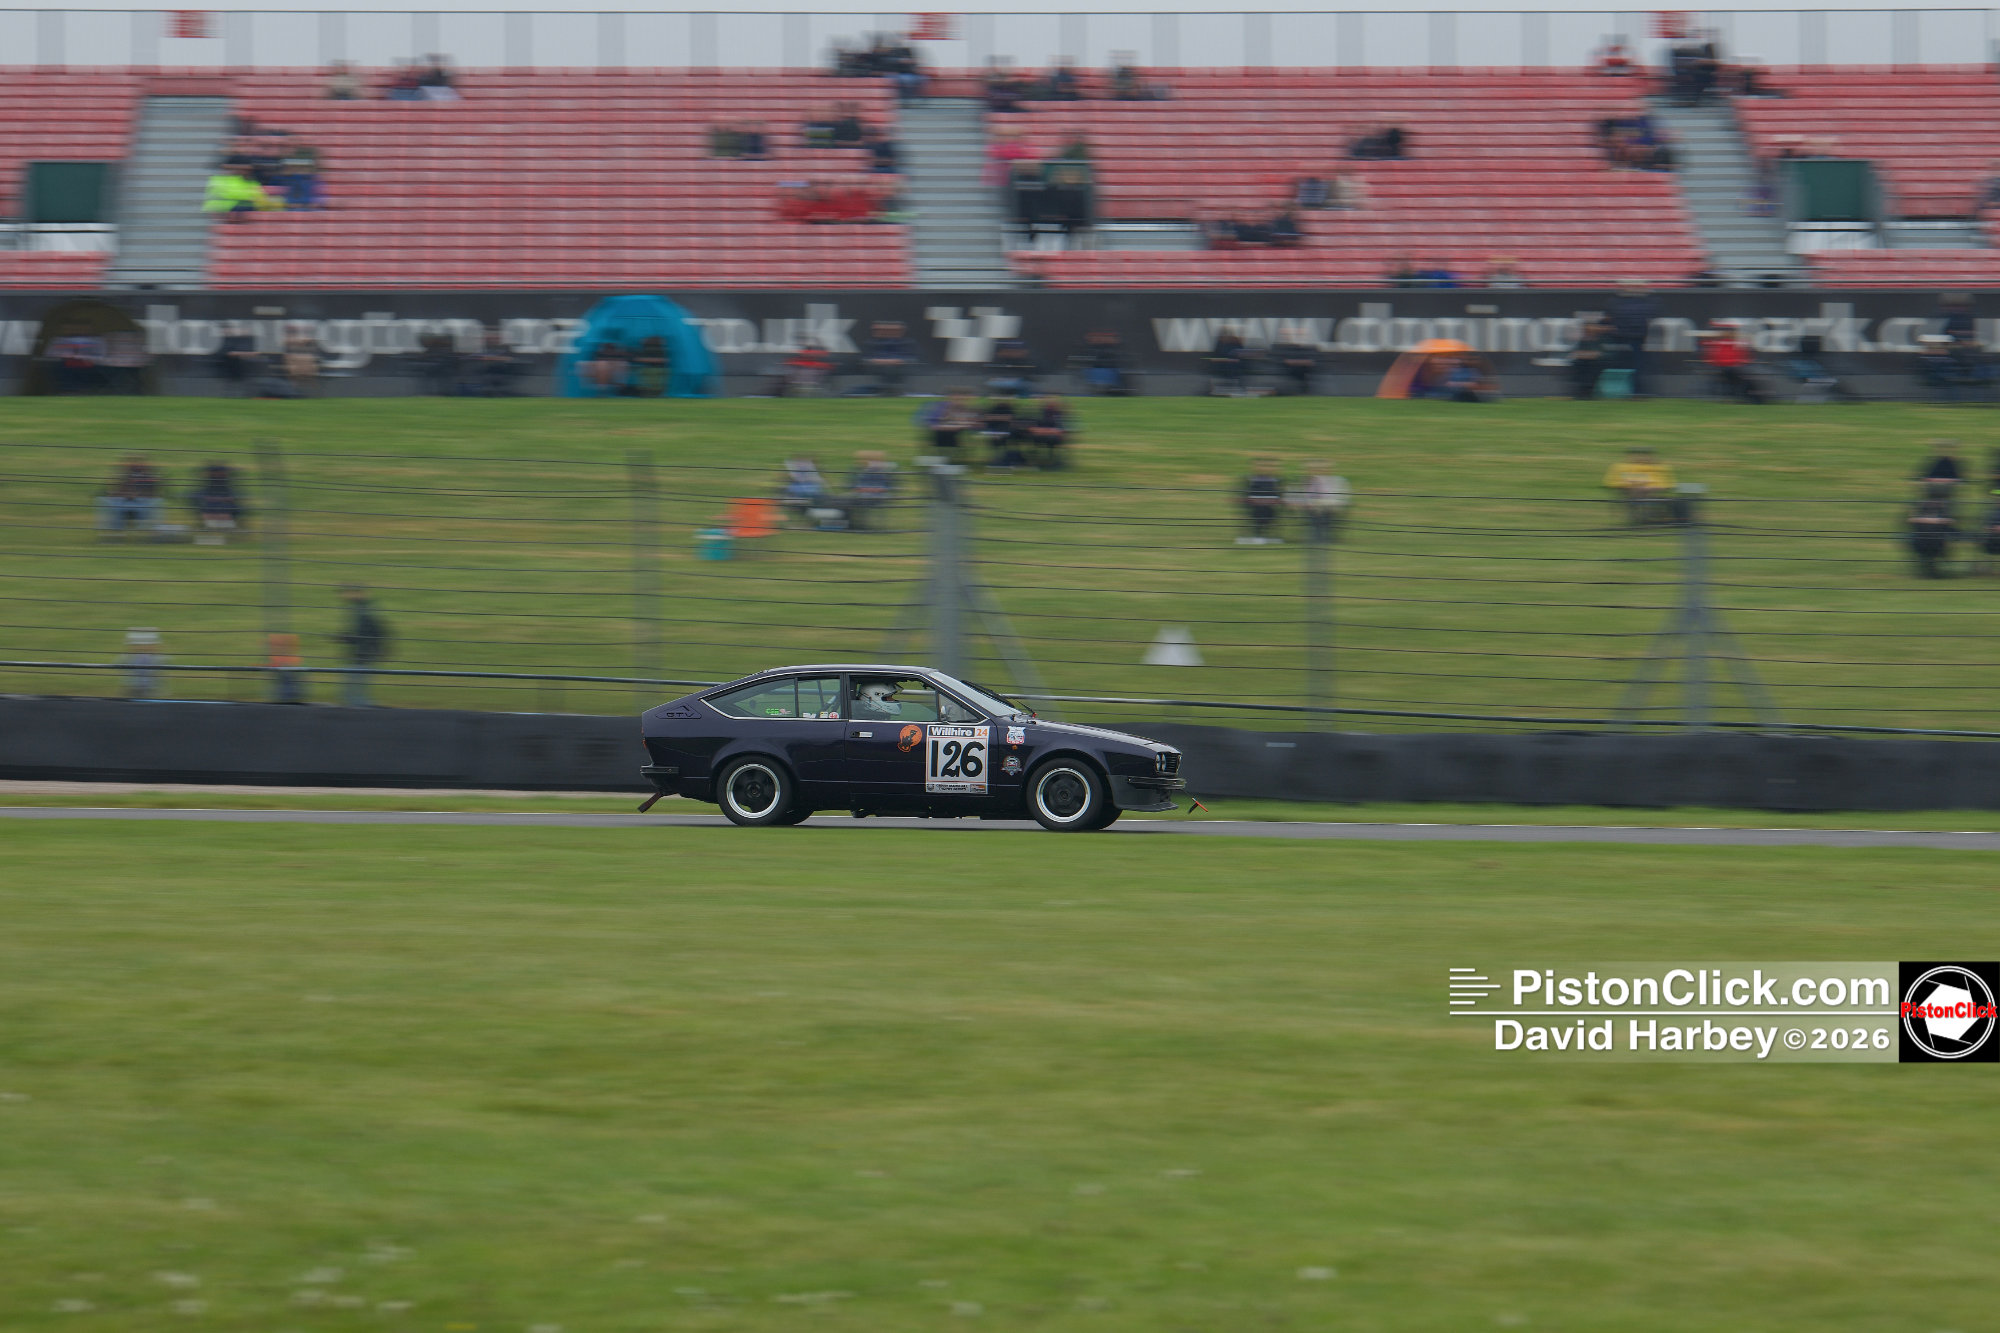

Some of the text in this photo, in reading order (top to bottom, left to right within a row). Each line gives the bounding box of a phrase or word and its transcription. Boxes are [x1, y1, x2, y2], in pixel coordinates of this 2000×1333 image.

[930, 726, 988, 736] Willhire 24
[930, 740, 985, 777] 126
